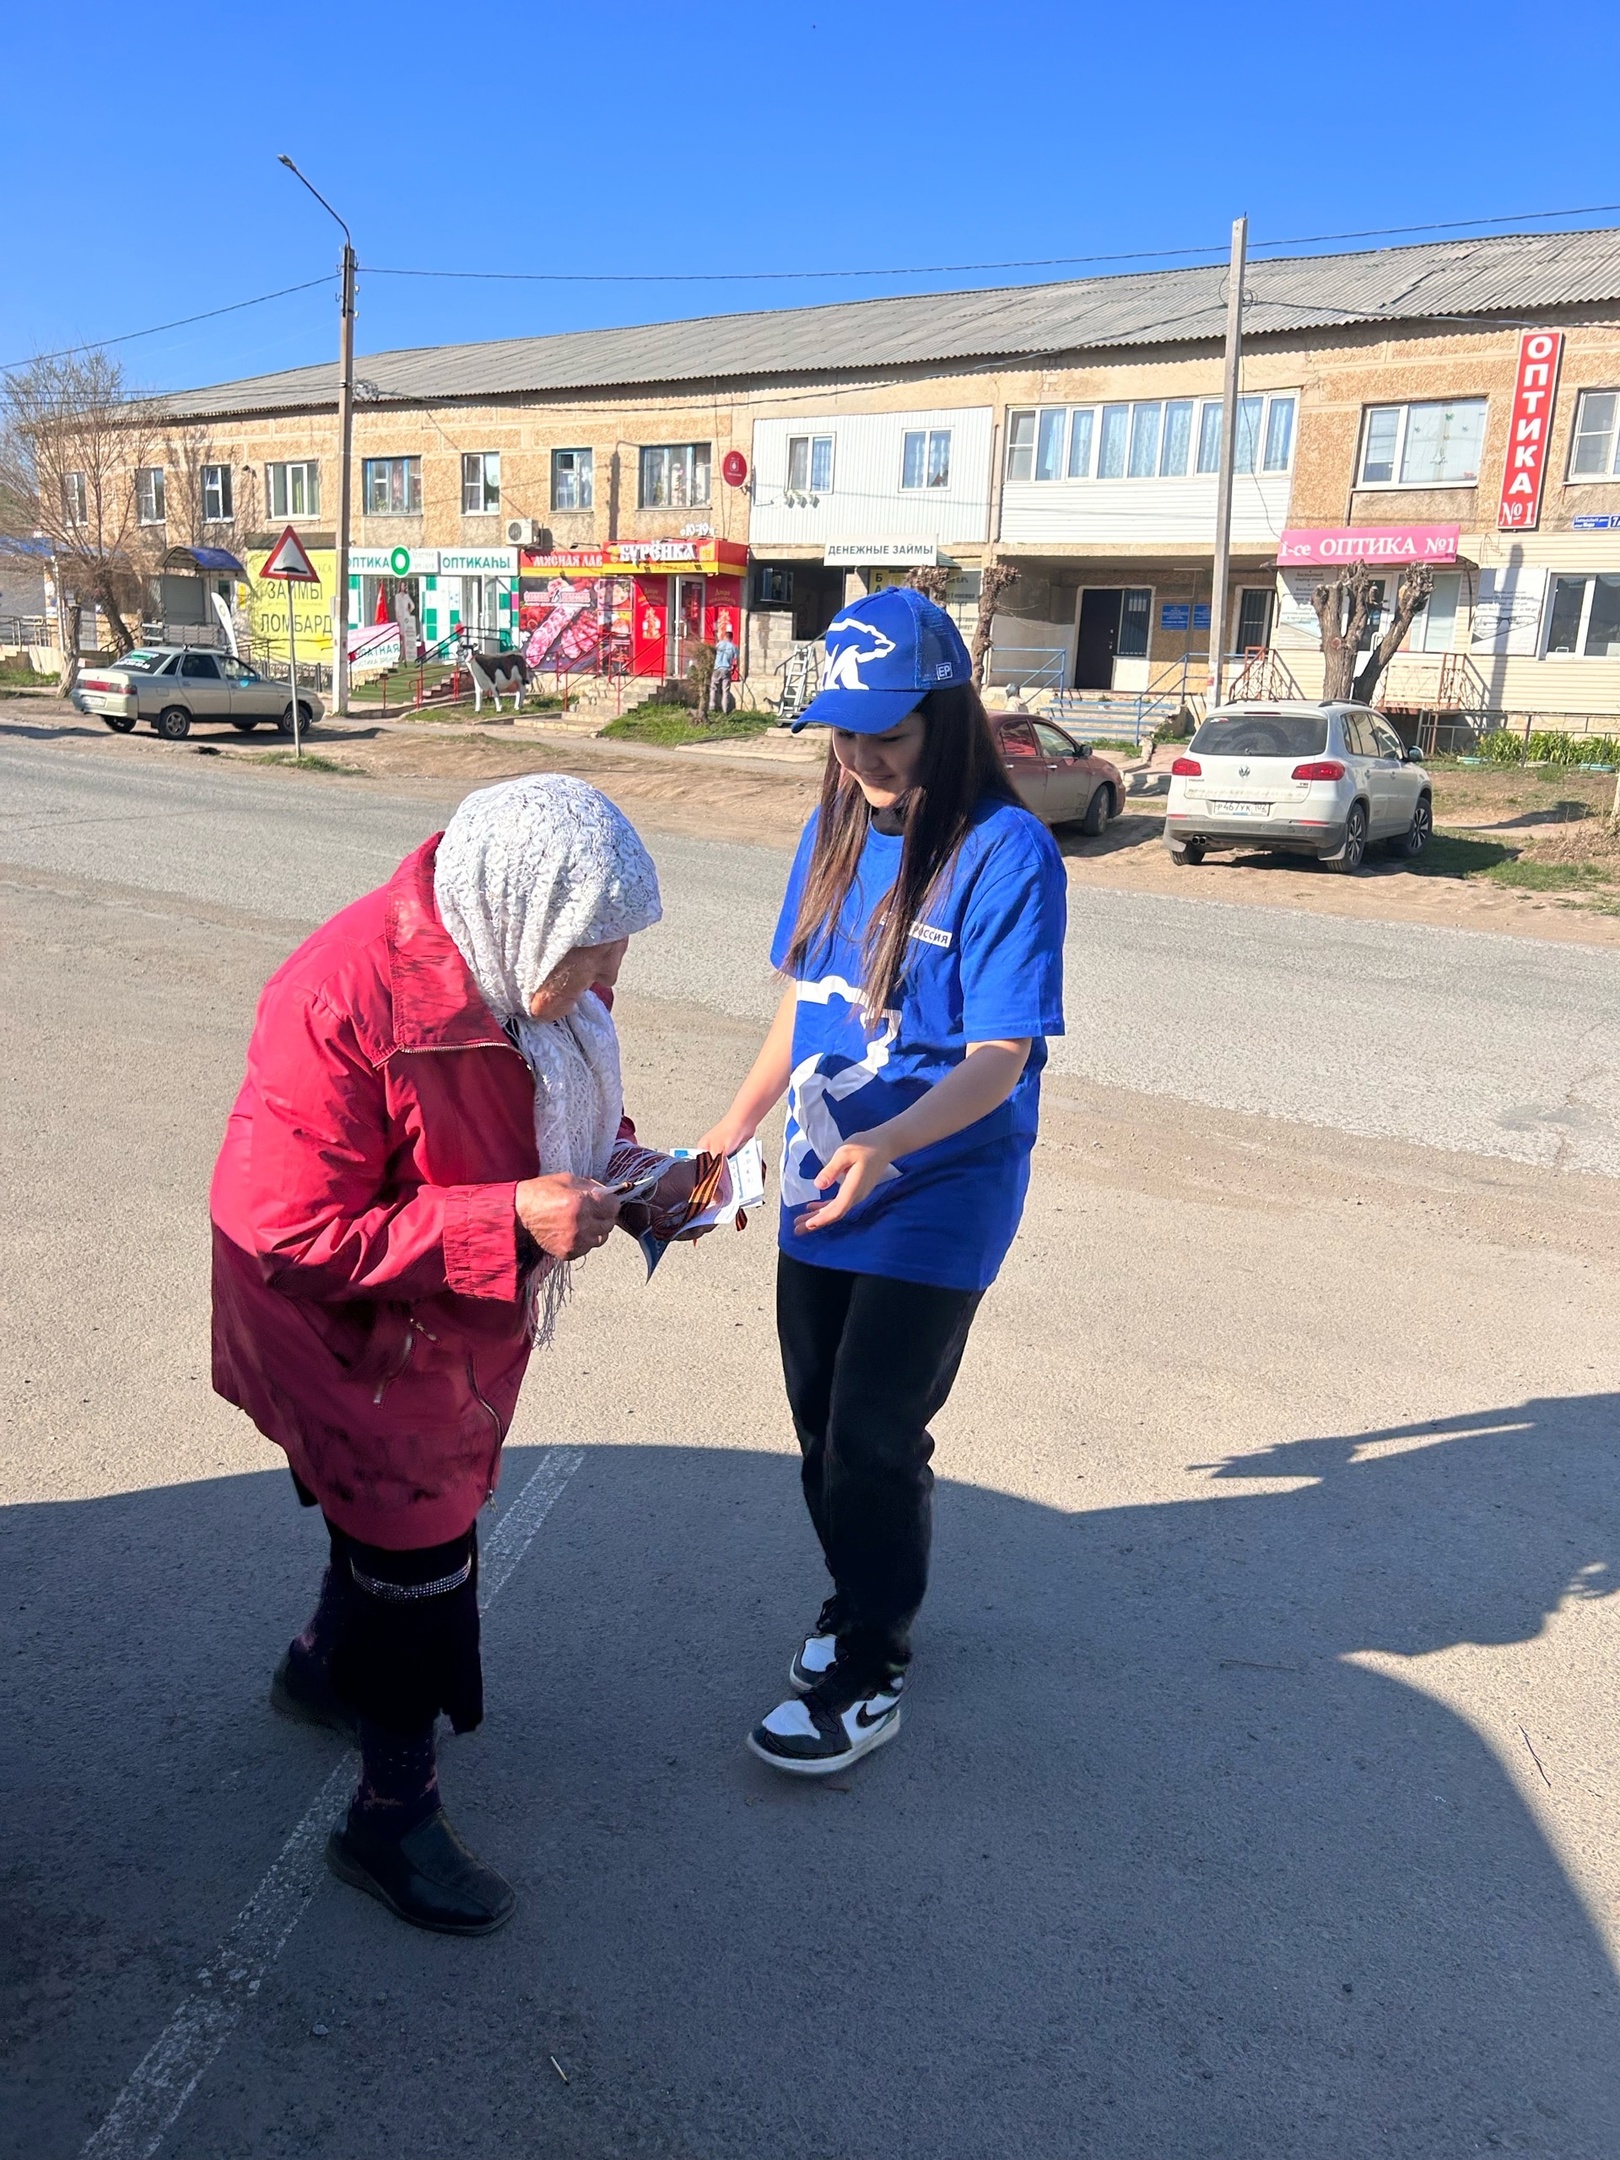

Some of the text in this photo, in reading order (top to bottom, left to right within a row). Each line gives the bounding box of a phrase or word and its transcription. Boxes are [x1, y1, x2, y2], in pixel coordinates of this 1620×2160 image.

[1507, 336, 1553, 495] ОПТИКА
[1500, 501, 1533, 526] №1
[620, 540, 697, 567] БУРЁНКА
[828, 543, 933, 555] ДЕНЕЖНЫЕ ЗАЙМЫ
[1319, 537, 1417, 556] ОПТИКА
[1424, 537, 1455, 554] №1
[533, 555, 580, 567] МЯСНАЯ
